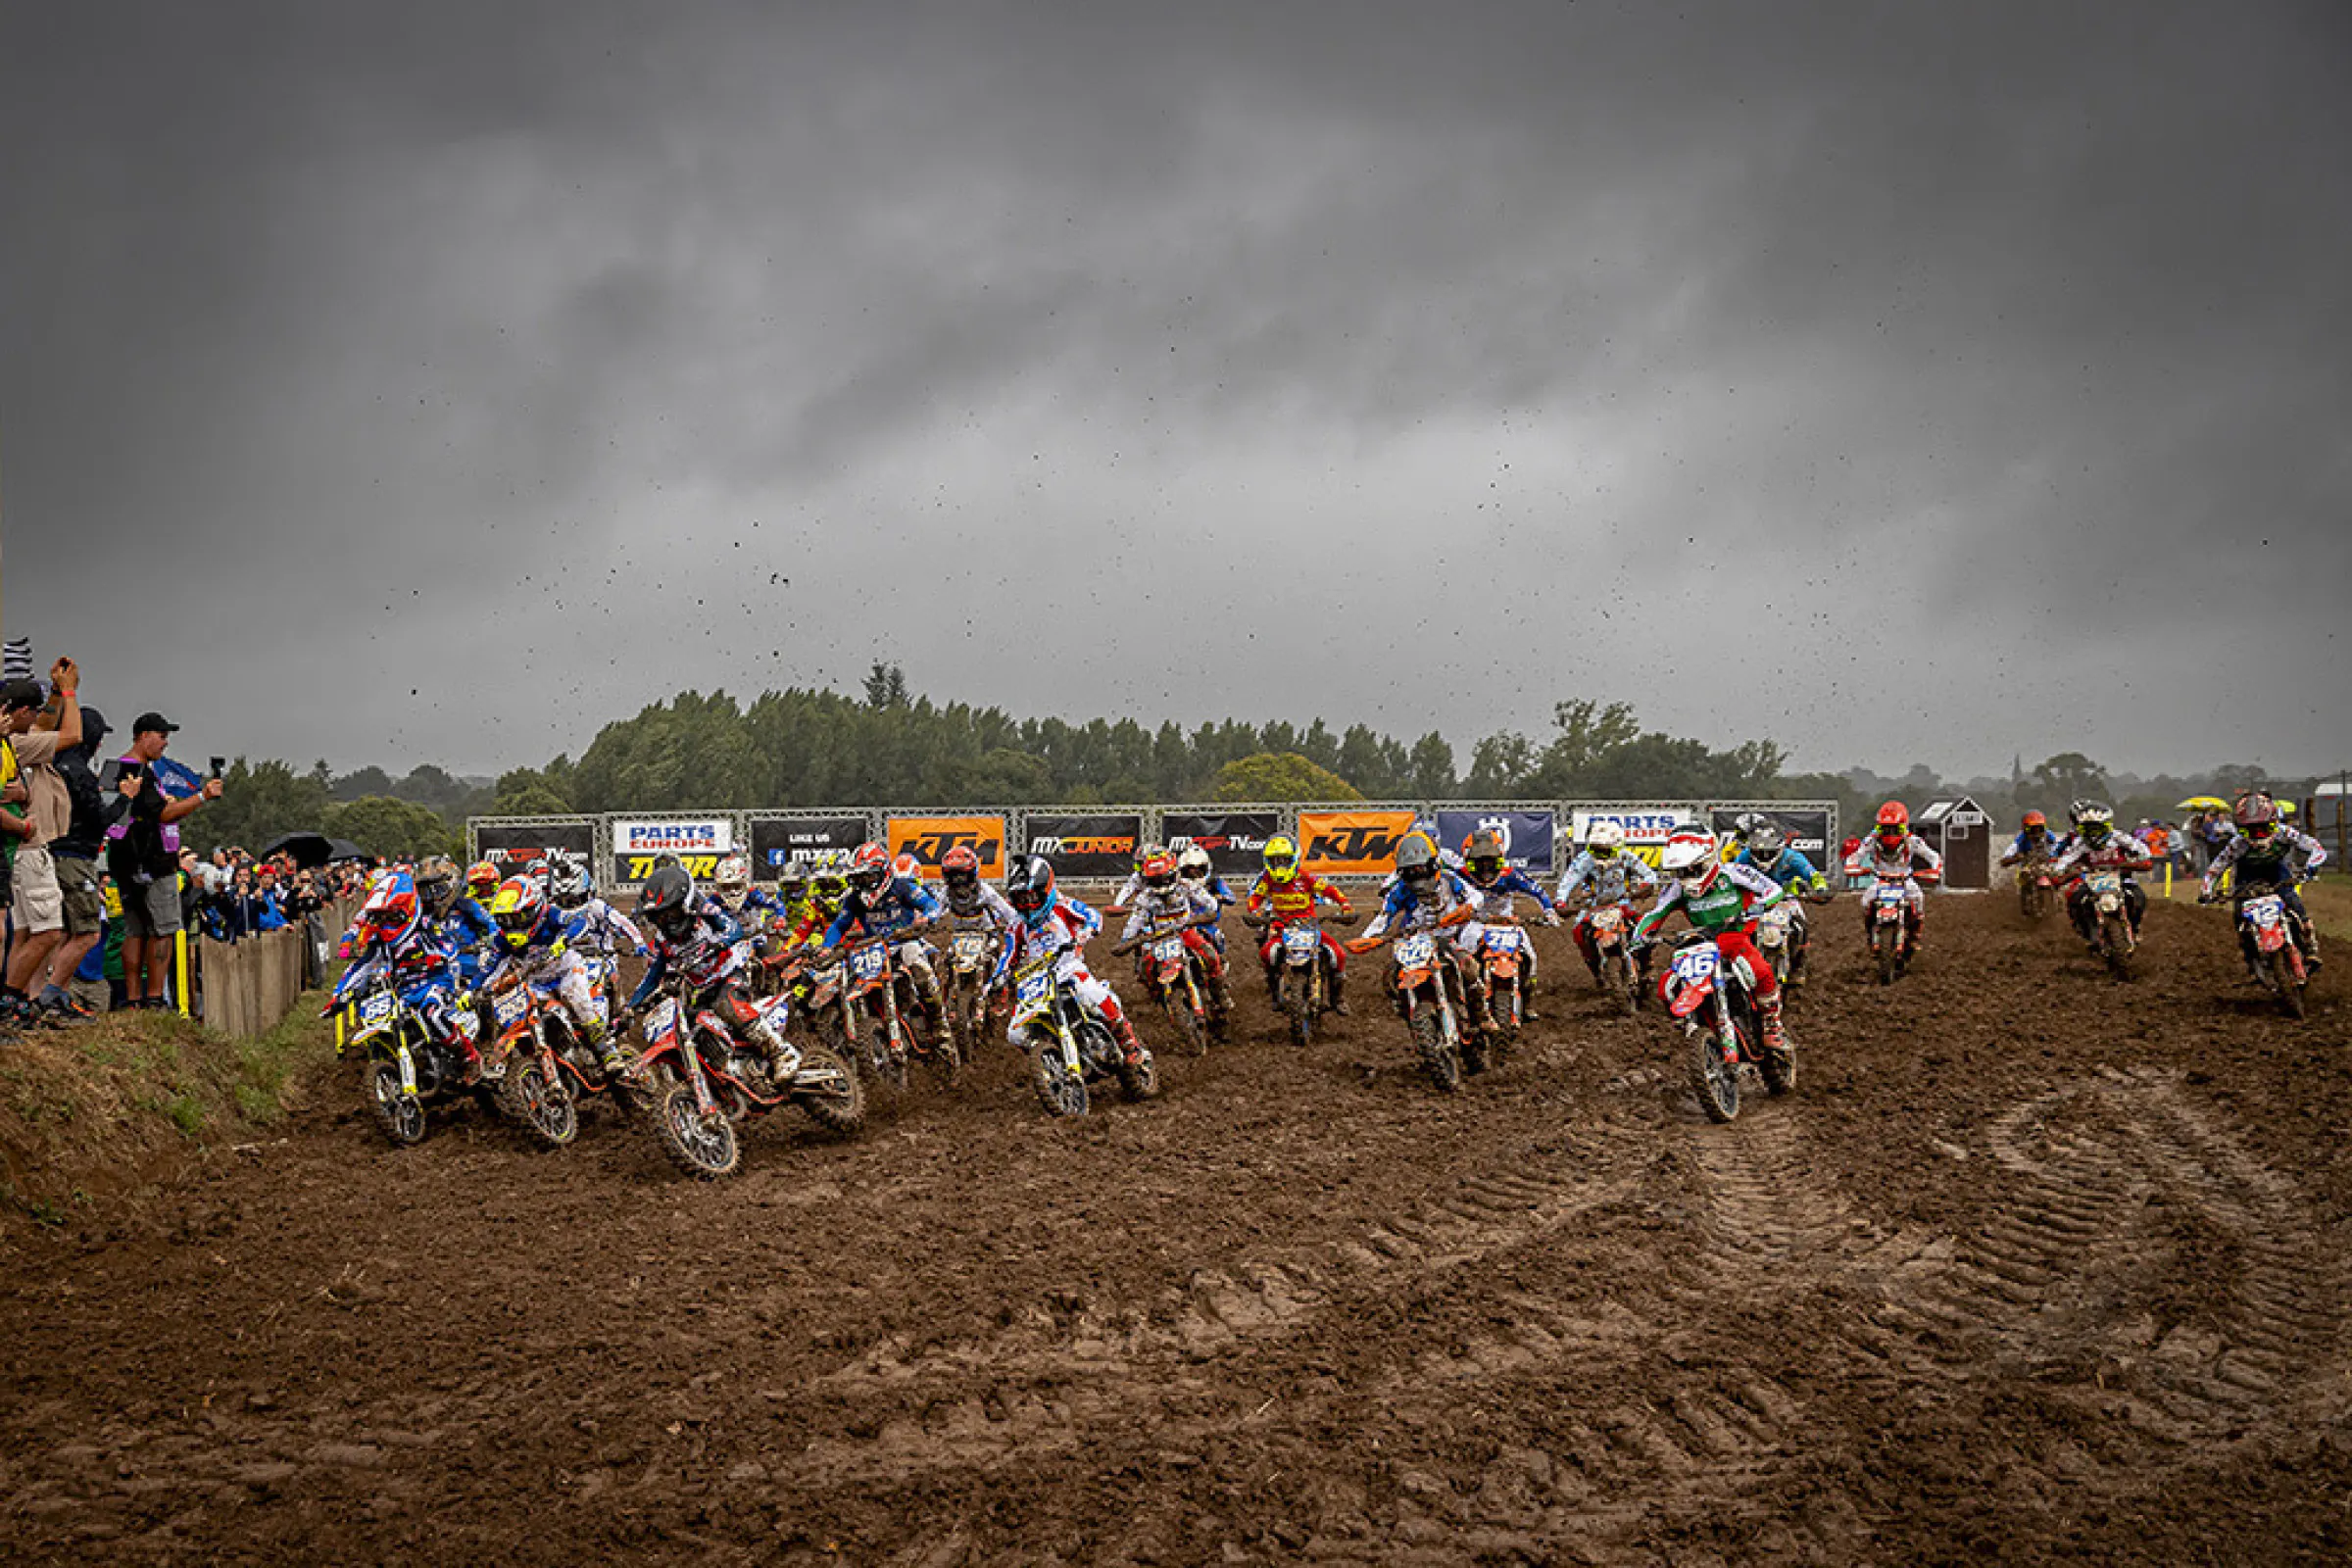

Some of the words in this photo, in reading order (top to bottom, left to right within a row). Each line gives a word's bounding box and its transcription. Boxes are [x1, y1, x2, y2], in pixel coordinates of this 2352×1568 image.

[629, 825, 714, 839] PARTS
[629, 839, 714, 849] EUROPE
[1679, 955, 1714, 978] 46
